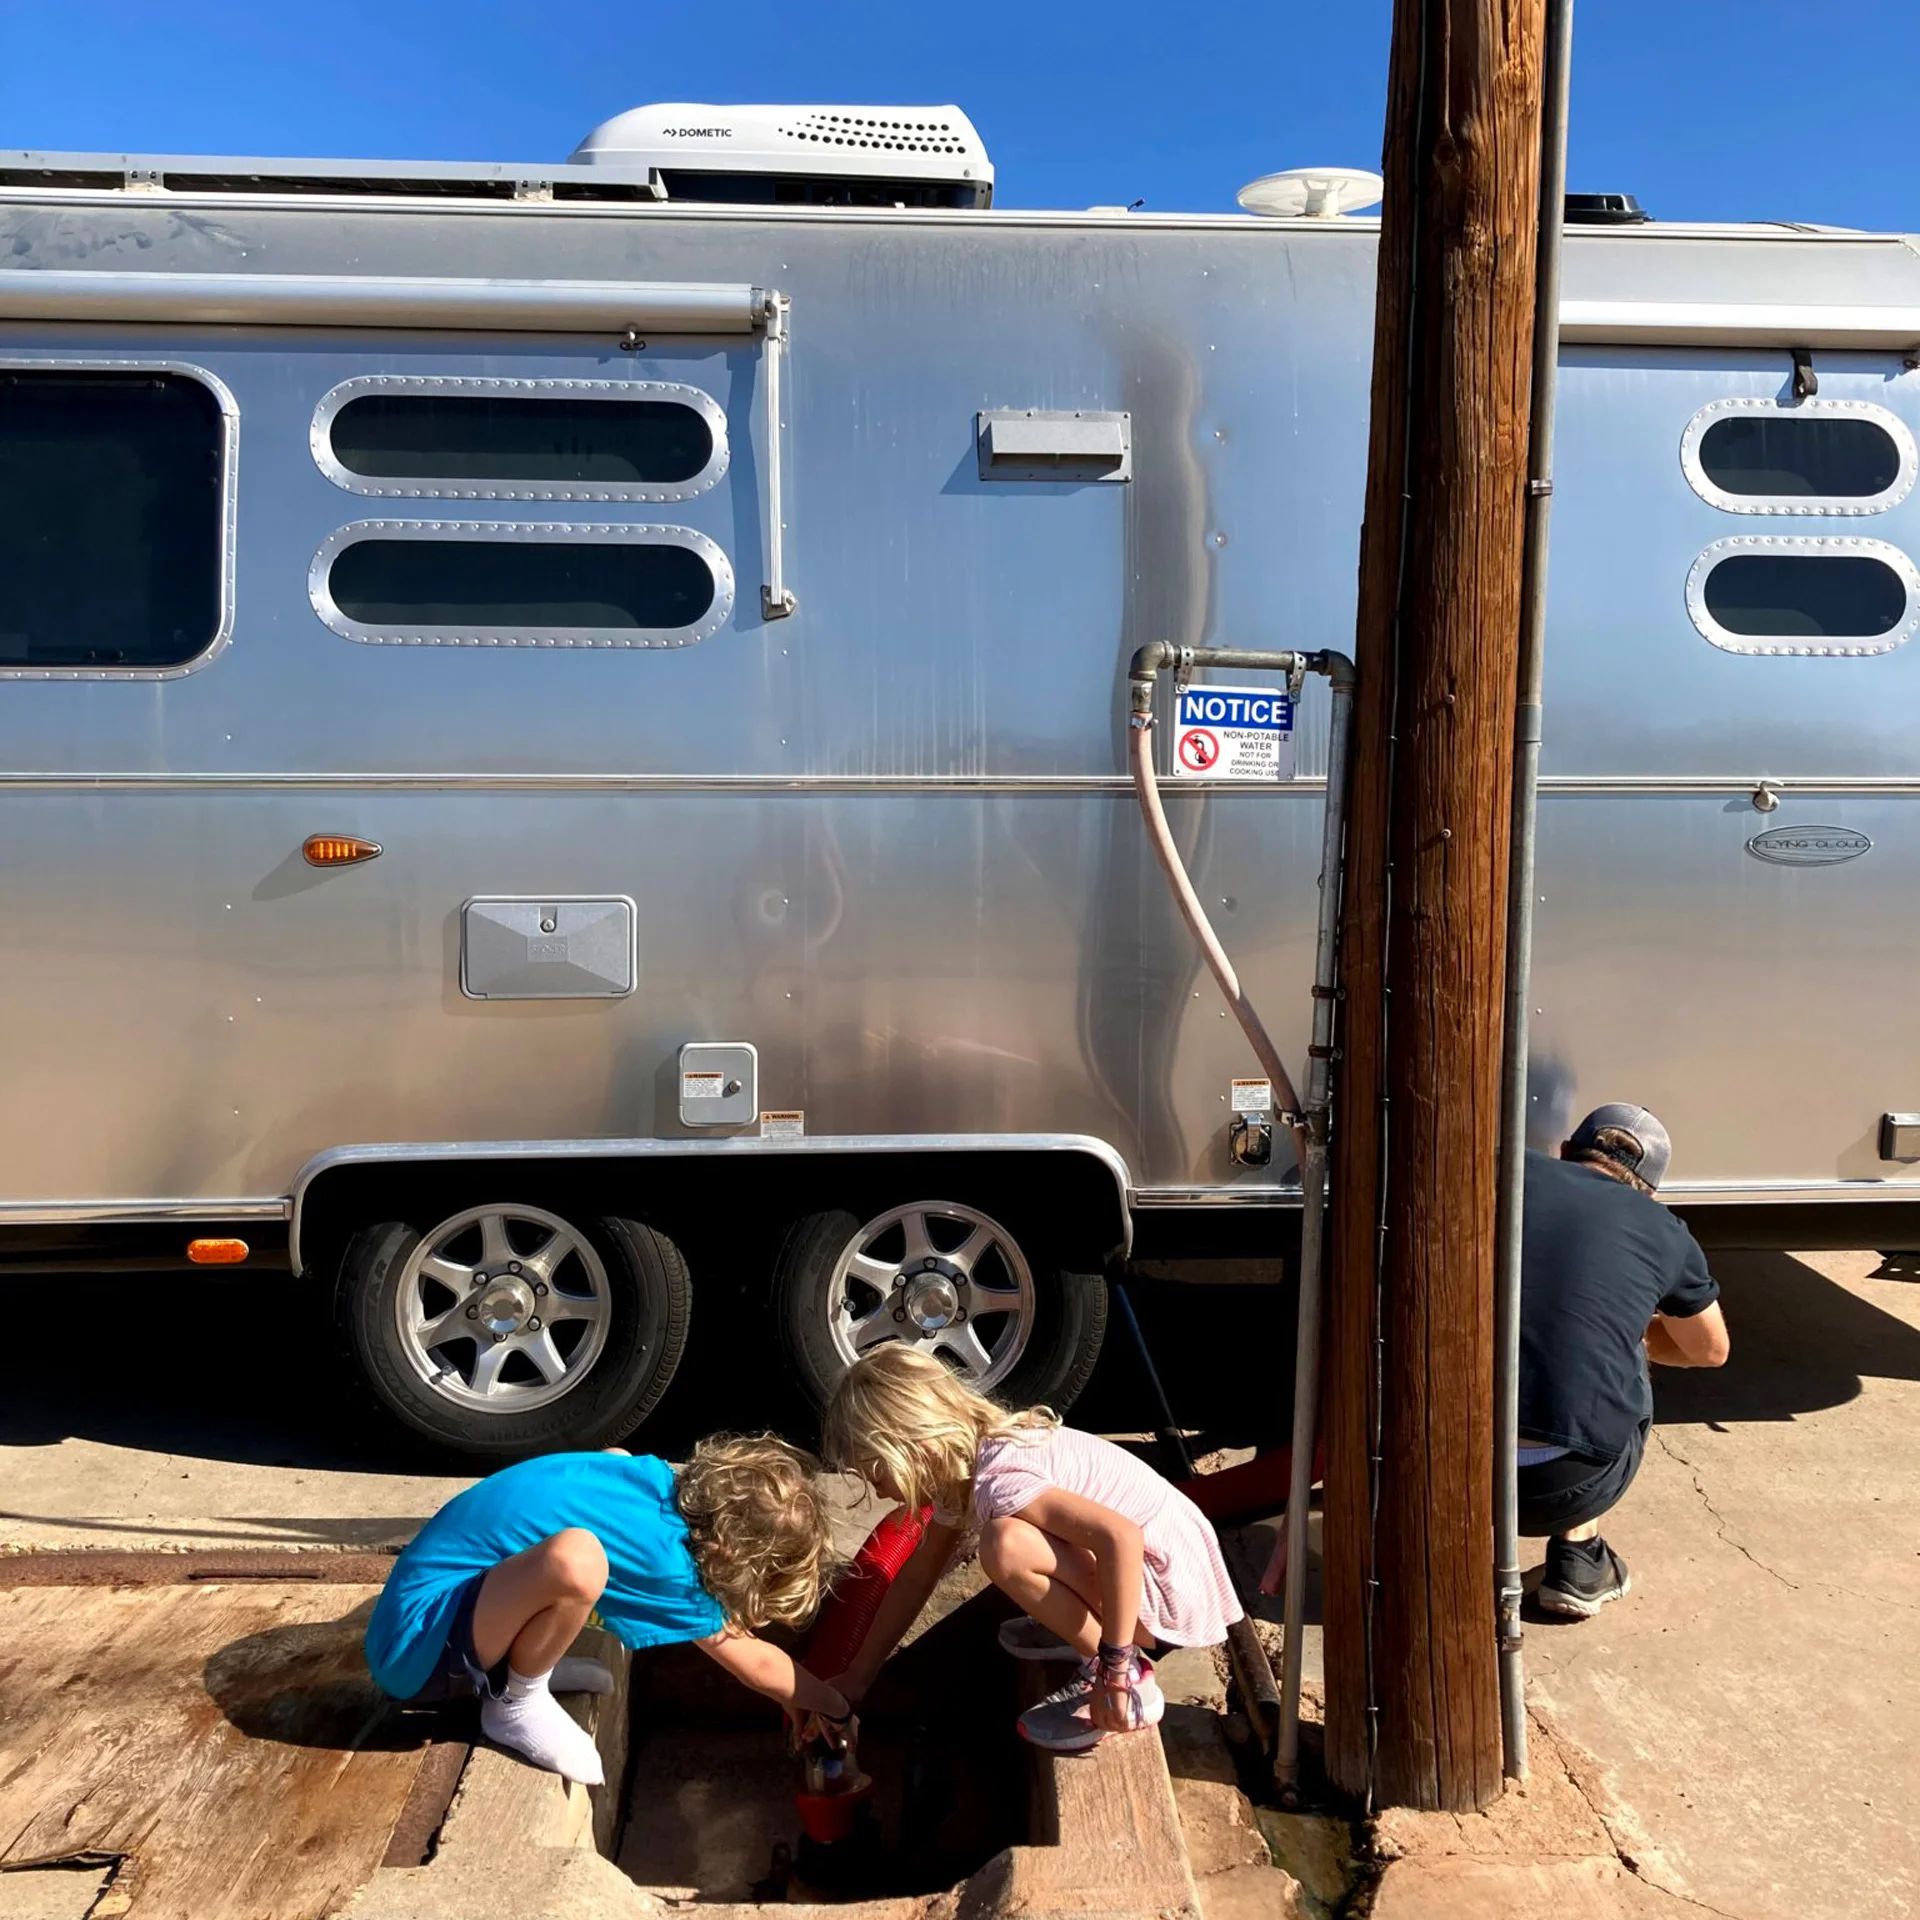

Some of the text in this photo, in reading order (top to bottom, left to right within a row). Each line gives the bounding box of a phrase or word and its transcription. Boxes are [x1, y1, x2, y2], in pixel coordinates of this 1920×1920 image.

[679, 128, 732, 137] DOMETIC
[1186, 697, 1287, 724] NOTICE
[1223, 730, 1289, 742] NON-POTABLE
[1239, 741, 1272, 751] WATER
[1239, 751, 1255, 759] NOT
[1231, 759, 1267, 768] DRINKING
[1229, 767, 1264, 776] COOKING
[1755, 840, 1808, 849] FLYING
